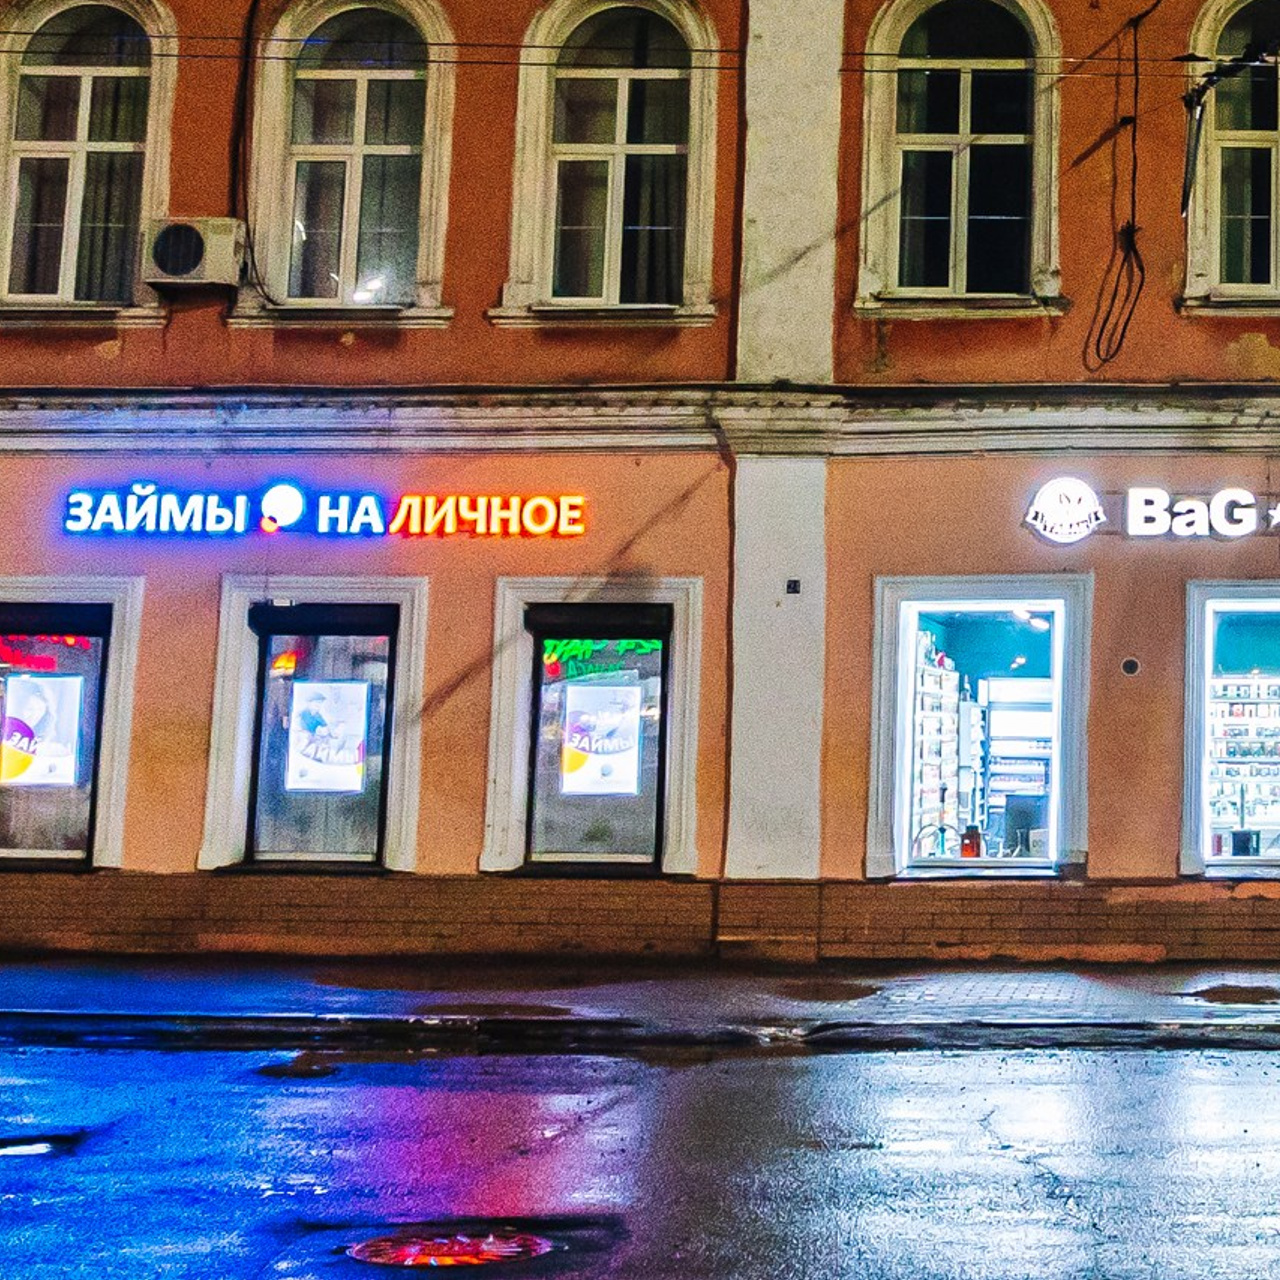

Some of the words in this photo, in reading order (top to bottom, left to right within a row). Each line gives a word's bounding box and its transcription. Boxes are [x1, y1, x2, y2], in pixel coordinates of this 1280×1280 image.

[65, 483, 248, 533] ЗАЙМЫ
[1127, 487, 1257, 536] BaG
[569, 733, 635, 753] ЗАЙМЫ
